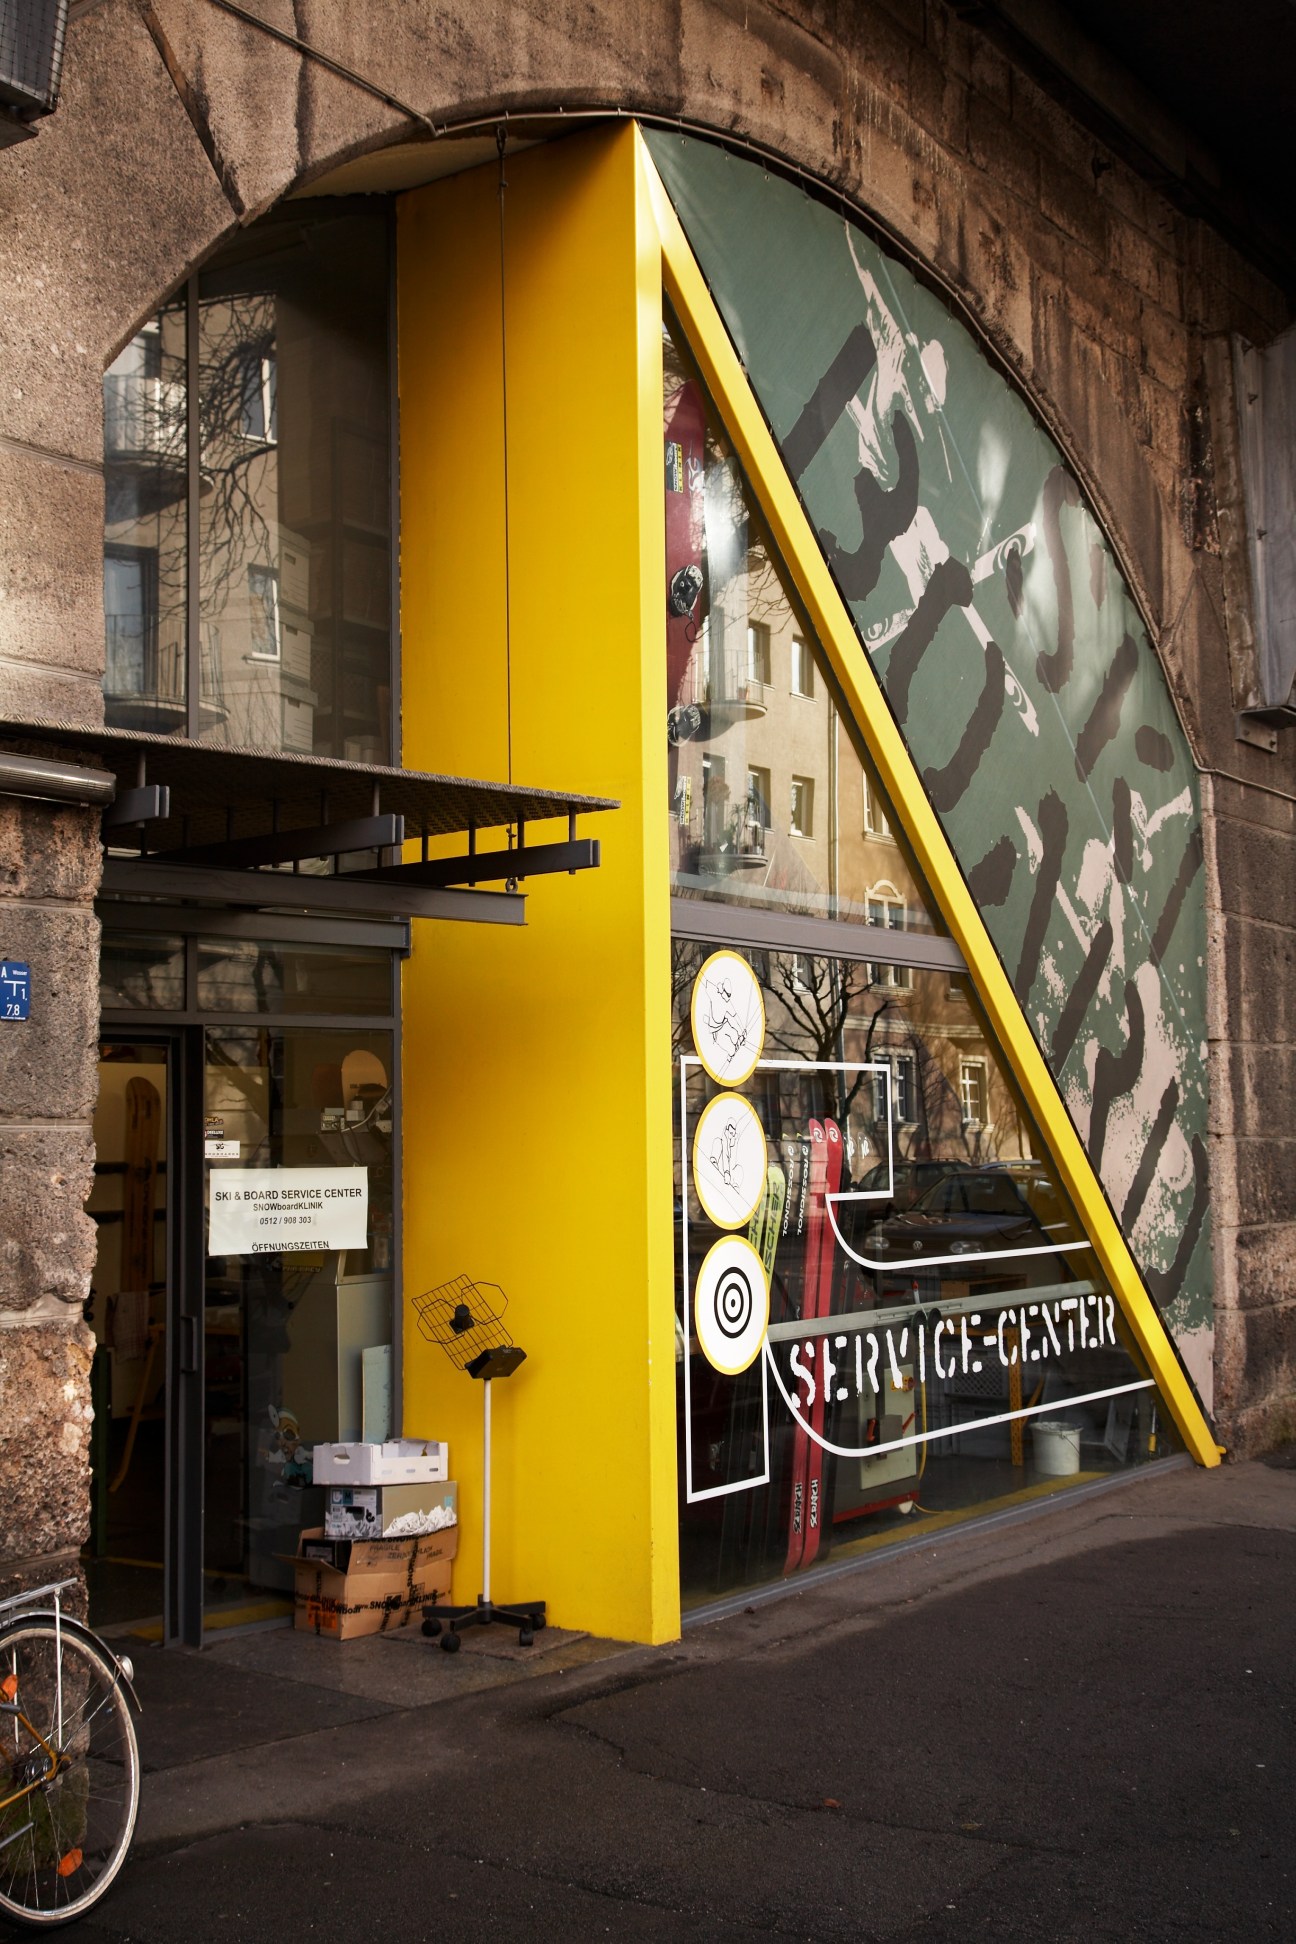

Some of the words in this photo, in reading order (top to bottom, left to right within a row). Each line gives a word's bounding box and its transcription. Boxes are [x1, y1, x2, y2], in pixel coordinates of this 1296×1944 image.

[1005, 464, 1205, 969] SKI
[783, 322, 1210, 1307] BOARD
[1, 966, 7, 978] A
[215, 1191, 232, 1201] SKI
[234, 1191, 242, 1200] &
[243, 1190, 279, 1200] BOARD
[281, 1189, 322, 1199] SERVICE
[324, 1188, 363, 1198] CENTER
[252, 1201, 324, 1211] SNOWboardKLINIK
[259, 1216, 278, 1225] 0512
[283, 1216, 297, 1225] 908
[298, 1216, 312, 1224] 303
[764, 1182, 780, 1275] ISCHER
[782, 1158, 795, 1237] ROSSIGNOL
[796, 1157, 809, 1236] ROSSIGNOL
[251, 1240, 330, 1252] ÖFFNUNGSZEITEN
[788, 1294, 1117, 1409] SERVICE-CENTER
